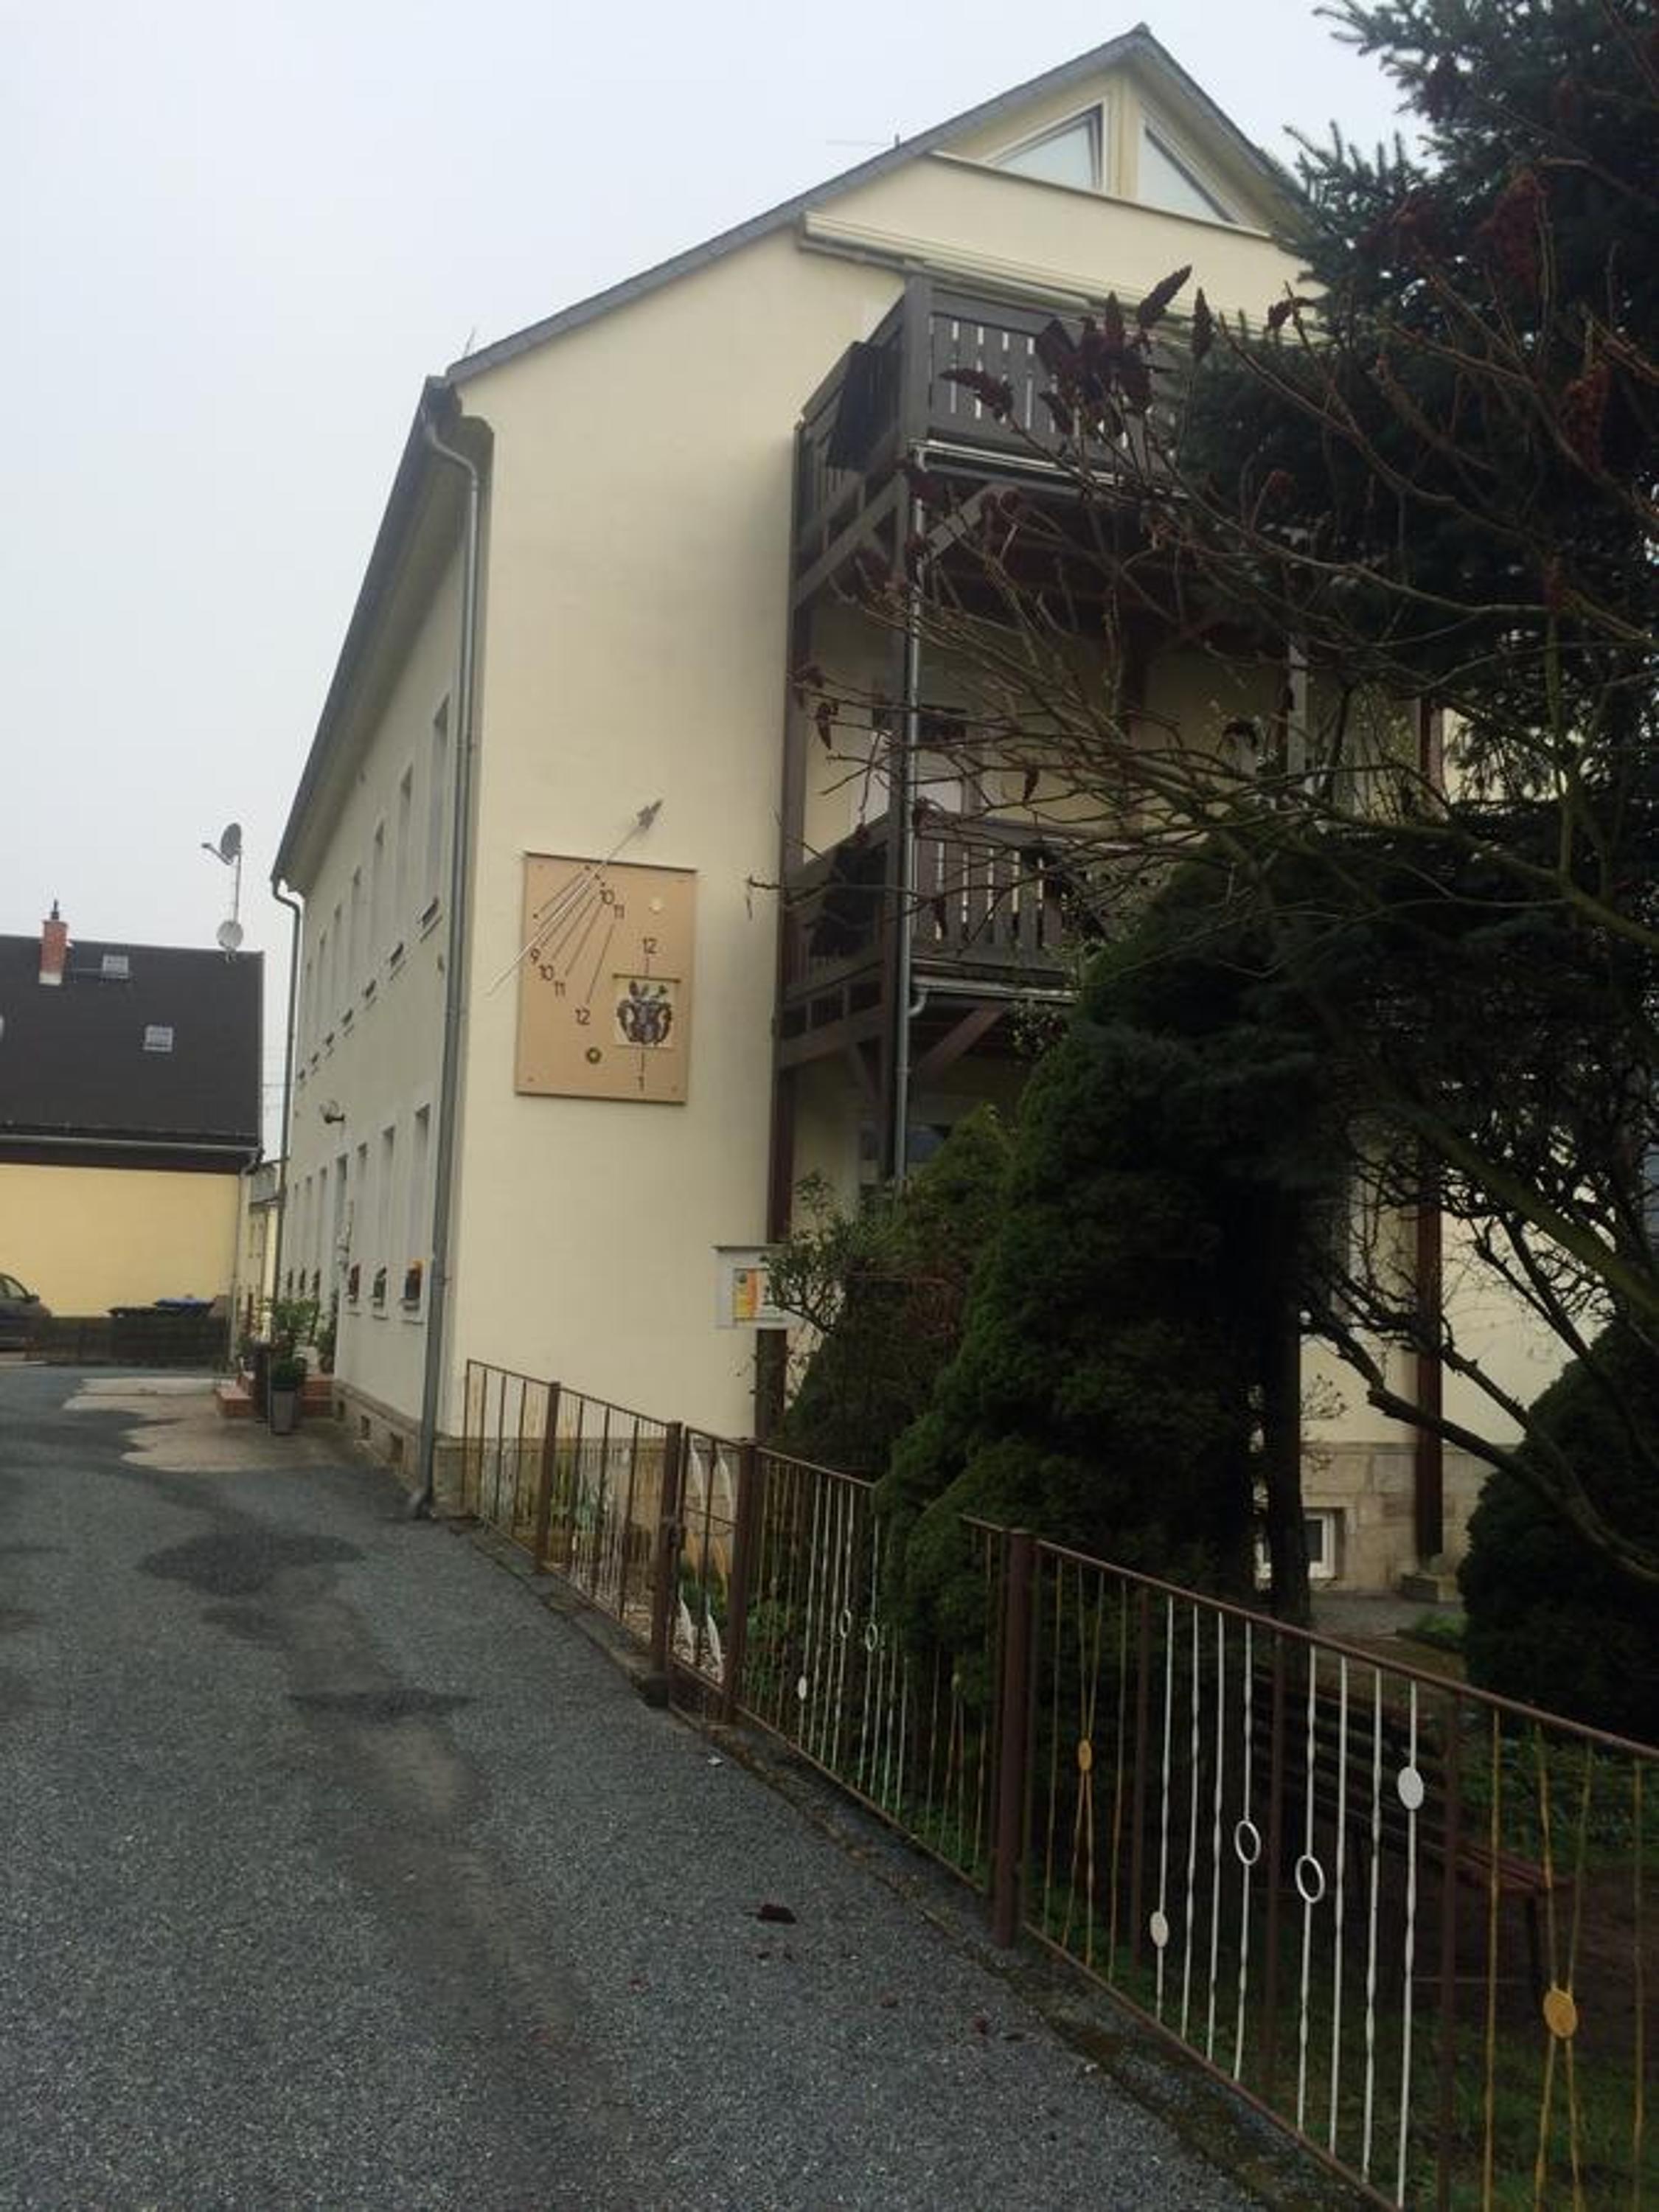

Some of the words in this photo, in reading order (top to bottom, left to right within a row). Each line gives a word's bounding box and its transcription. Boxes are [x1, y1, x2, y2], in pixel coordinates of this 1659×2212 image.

[643, 937, 658, 954] 12
[530, 947, 541, 966] 9
[538, 964, 554, 981] 10
[554, 981, 566, 998] 11
[575, 1008, 591, 1026] 12
